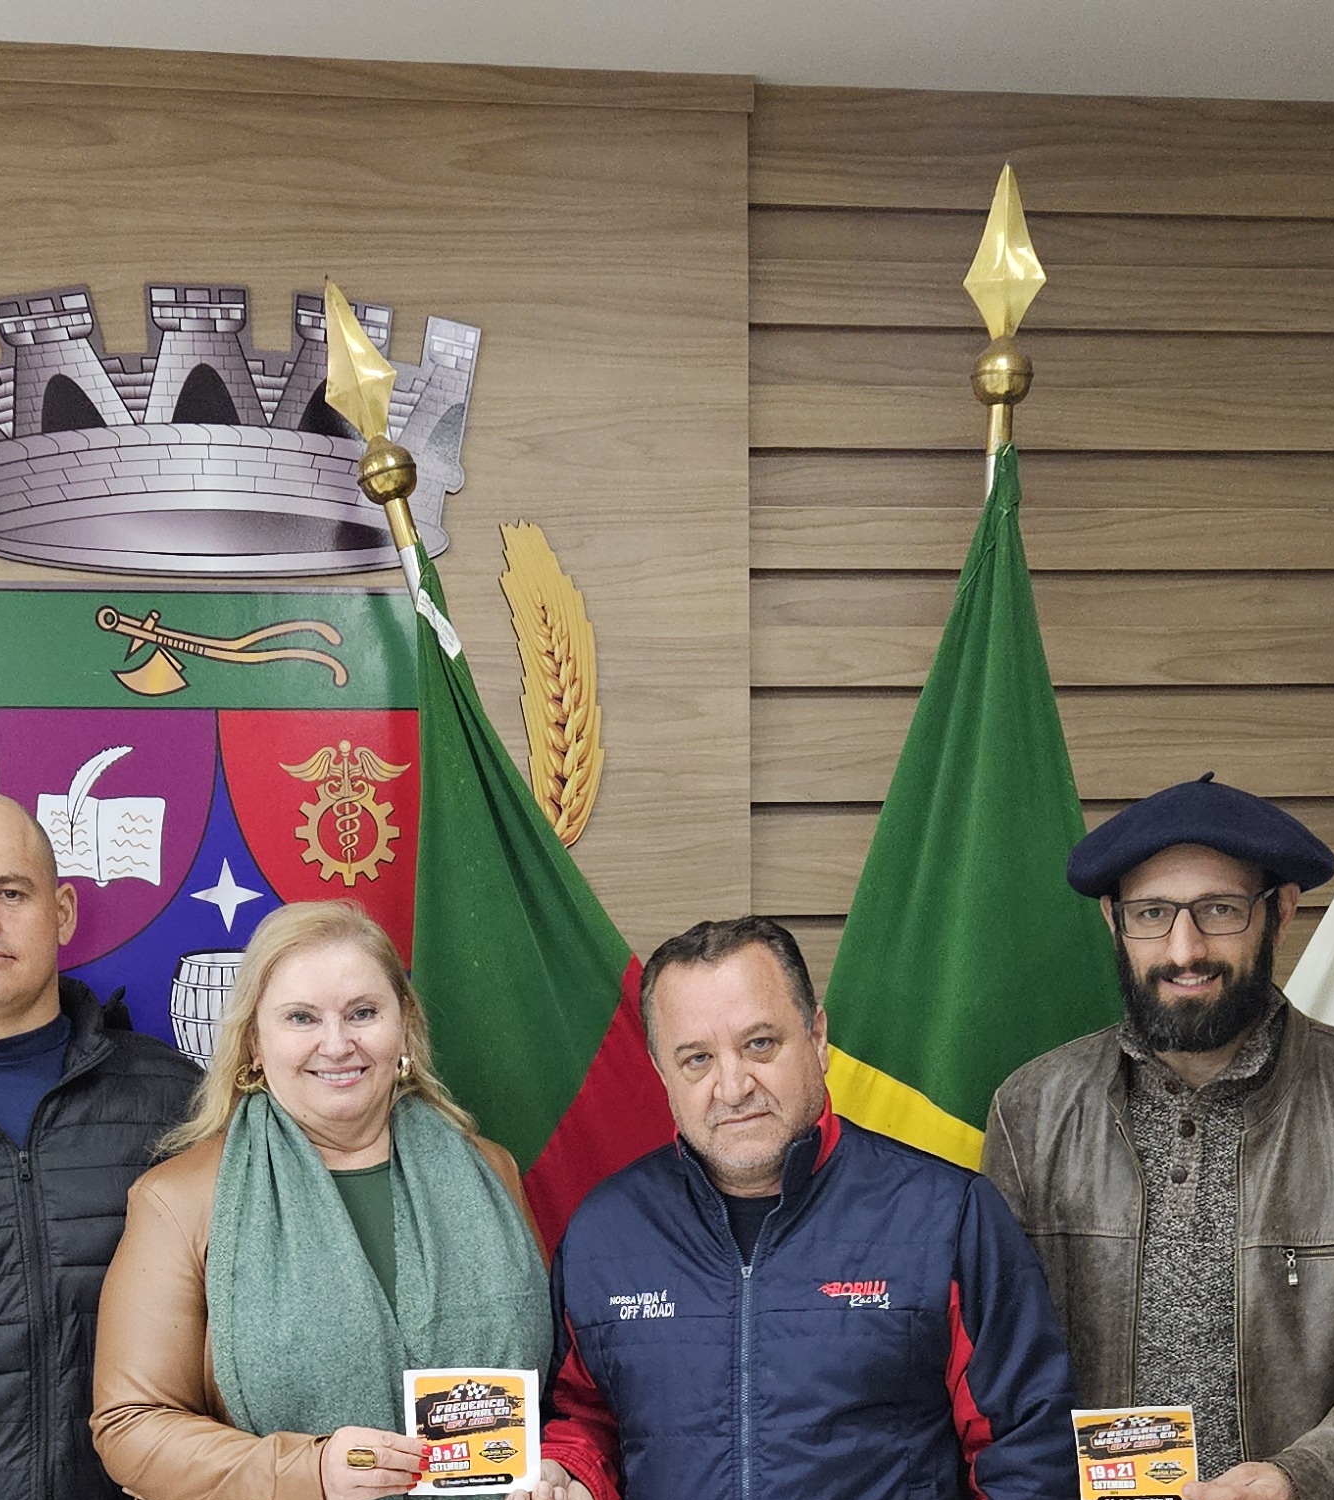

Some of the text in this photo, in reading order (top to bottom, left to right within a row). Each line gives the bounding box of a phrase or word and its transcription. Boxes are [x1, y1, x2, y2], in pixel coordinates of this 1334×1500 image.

[609, 1295, 636, 1305] NOSSA
[636, 1291, 660, 1305] VIDA
[619, 1305, 640, 1320] OFF
[443, 1449, 452, 1460] a
[452, 1443, 468, 1459] 21
[1088, 1465, 1106, 1480] 19
[1107, 1468, 1116, 1478] a
[1116, 1463, 1134, 1477] 21
